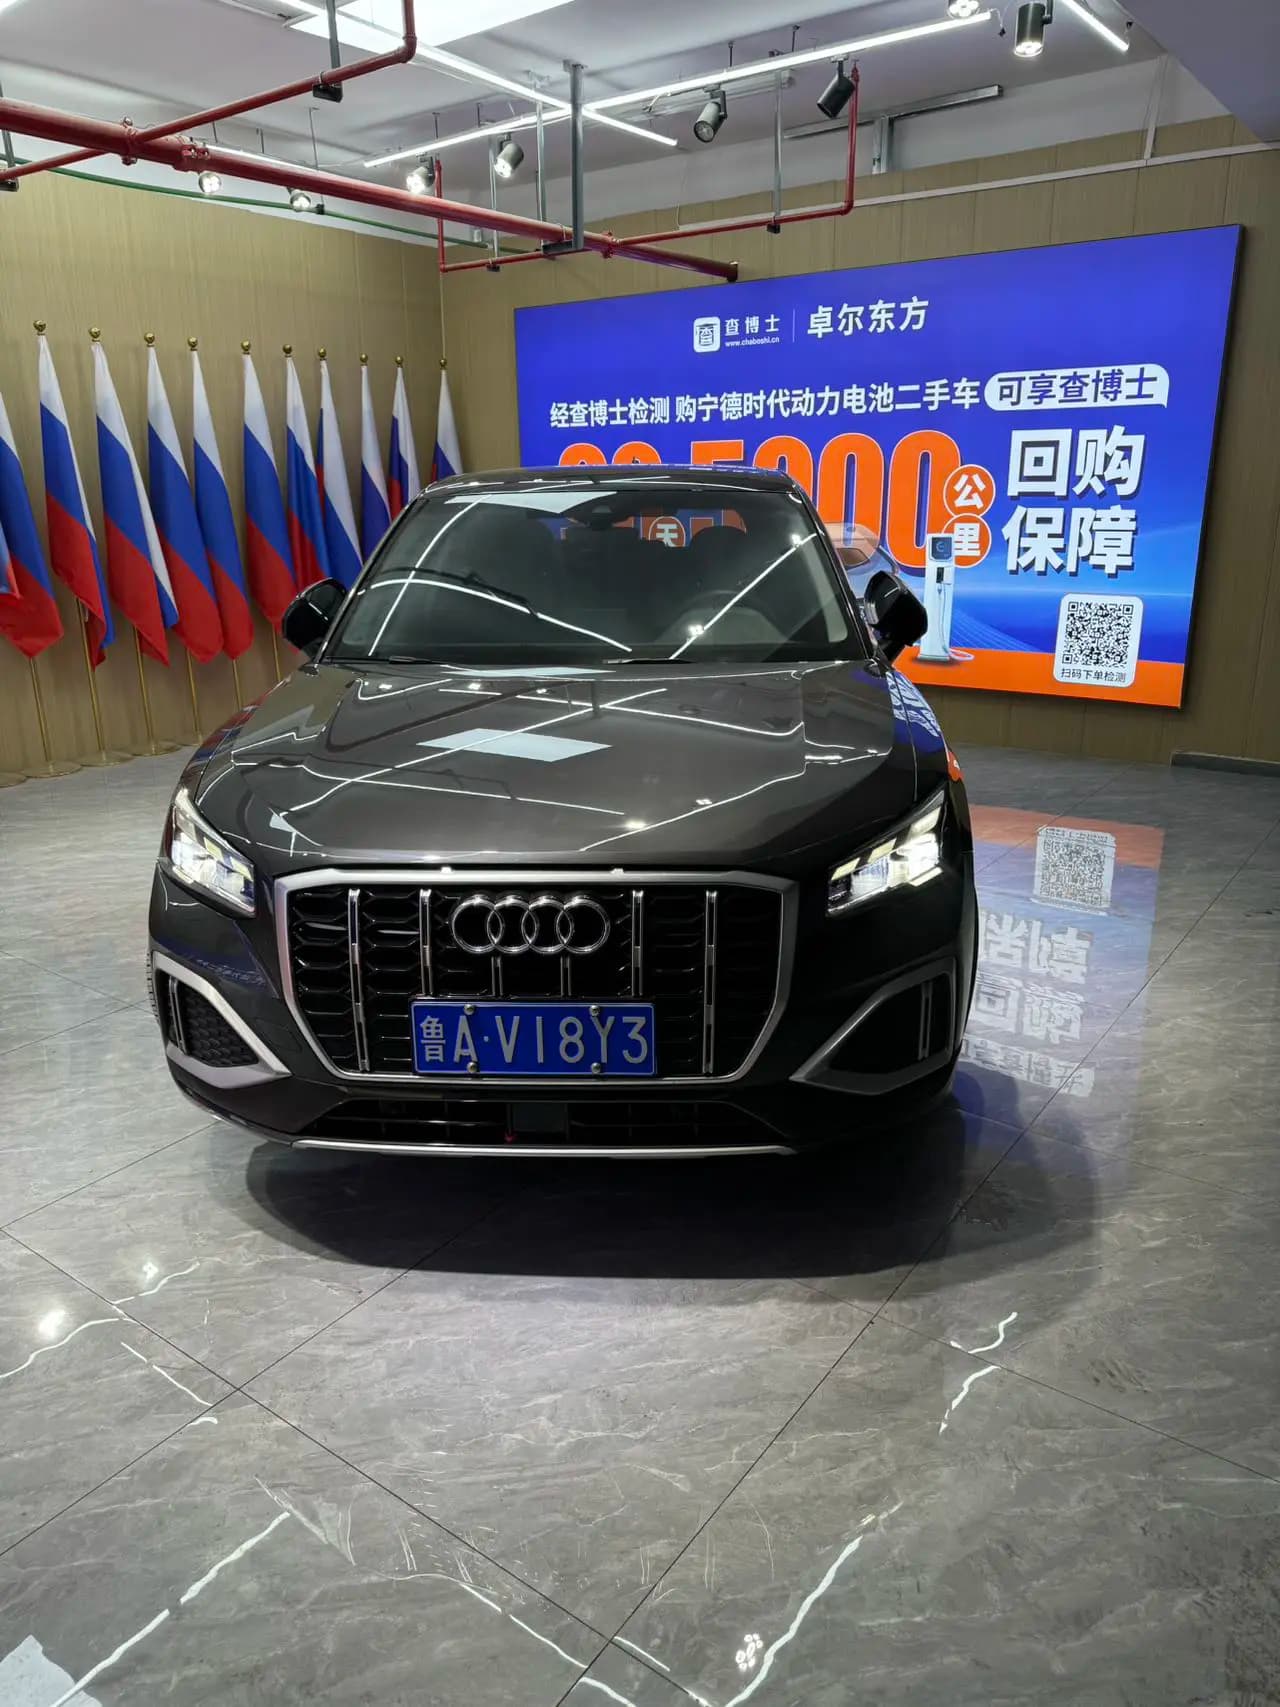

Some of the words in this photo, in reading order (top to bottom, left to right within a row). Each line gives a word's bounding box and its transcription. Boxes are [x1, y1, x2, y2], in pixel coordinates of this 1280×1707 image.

[724, 314, 780, 336] 查博士
[808, 296, 928, 338] 卓尔东方
[550, 396, 670, 428] 经查博士检测
[675, 377, 980, 423] 购宁德时代动力电池二手车
[998, 367, 1157, 406] 可享查博士
[1007, 425, 1145, 496] 回购
[952, 473, 986, 557] 公里
[1001, 505, 1136, 574] 保障
[1060, 667, 1126, 683] 扫码下单检测
